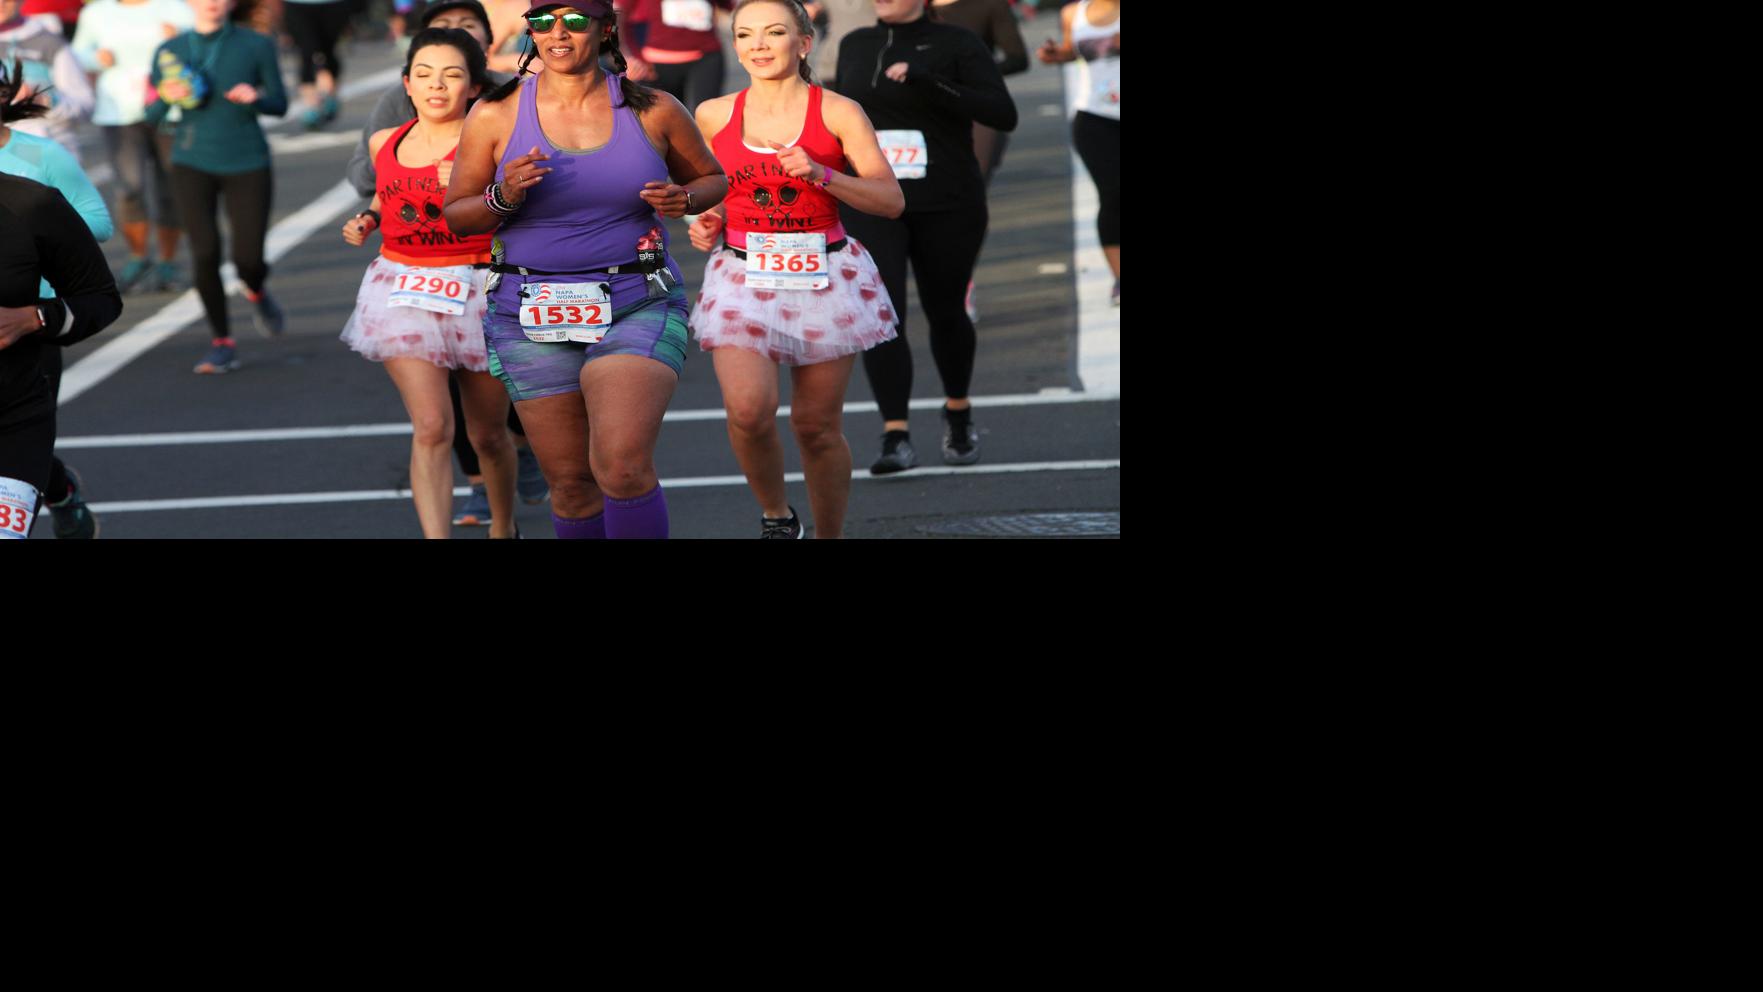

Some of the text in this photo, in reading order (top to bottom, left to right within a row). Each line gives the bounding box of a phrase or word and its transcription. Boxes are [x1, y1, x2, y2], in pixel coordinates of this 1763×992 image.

[756, 252, 820, 273] 1365
[399, 274, 461, 299] 1290
[528, 304, 603, 326] 1532
[0, 503, 27, 533] 83
